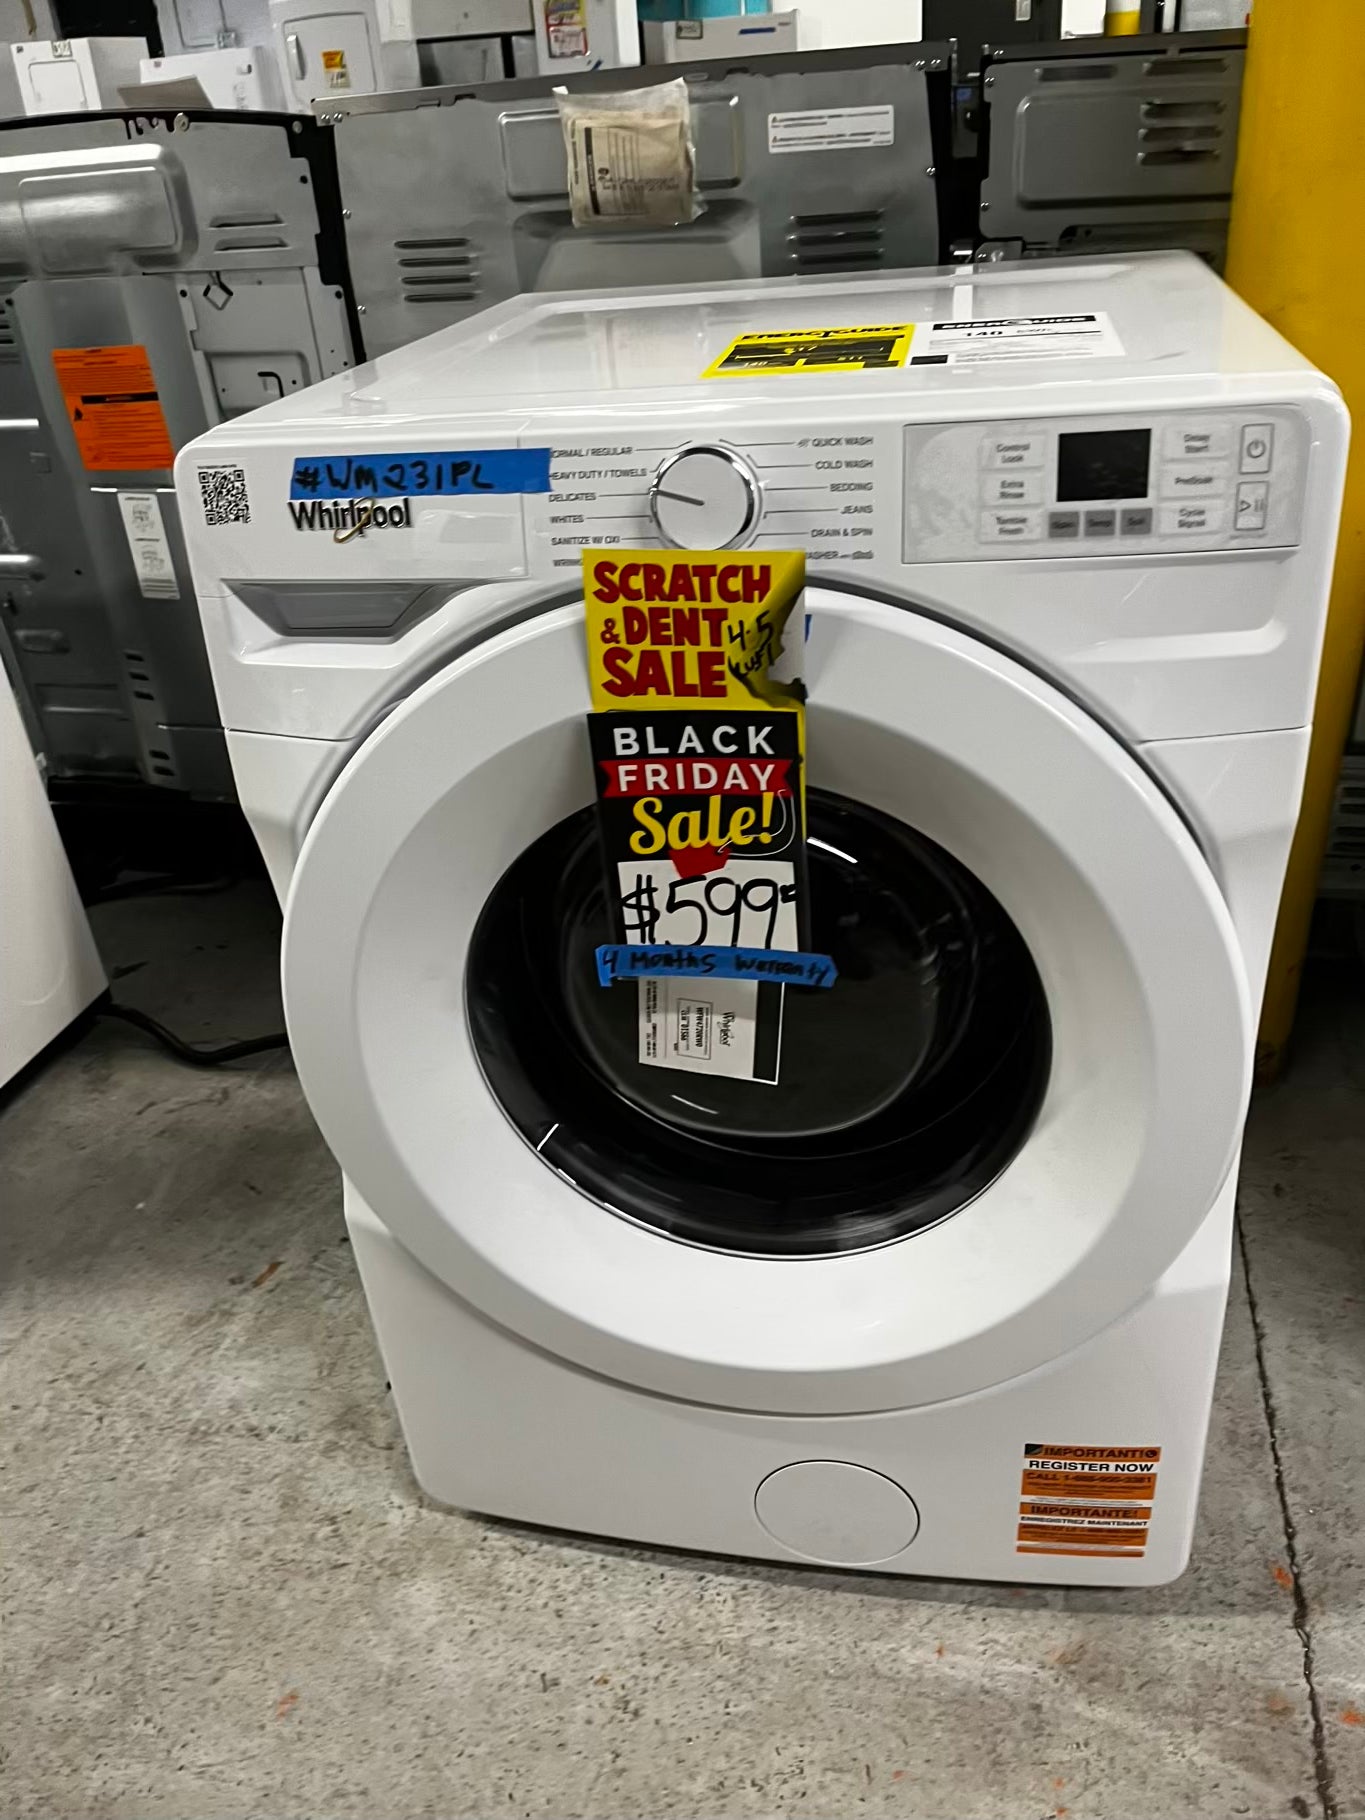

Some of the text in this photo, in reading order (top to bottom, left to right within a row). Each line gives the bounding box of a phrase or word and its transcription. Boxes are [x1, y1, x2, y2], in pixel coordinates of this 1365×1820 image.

[812, 436, 874, 447] QUICK WASH
[591, 447, 633, 457] REGULAR
[815, 459, 874, 470] COLD WASH
[579, 470, 603, 480] DUTY
[611, 468, 647, 478] TOWELS
[830, 481, 873, 492] BEDDING
[548, 492, 596, 503] DELICATES
[840, 504, 874, 515] JEANS
[287, 497, 414, 541] Whirlpool
[550, 514, 584, 524] WHITES
[810, 528, 841, 538] DRAIN
[850, 528, 873, 537] SPIN
[550, 535, 591, 546] SANITIZE
[593, 561, 771, 603] SCRATCH
[600, 606, 729, 647] & DENT
[601, 647, 728, 698] SALE
[613, 725, 775, 756] BLACK
[617, 763, 776, 792] FRIDAY
[629, 792, 775, 855] Sale!
[602, 949, 617, 974] 4
[1044, 1447, 1143, 1459] IMPORTANT!
[1029, 1460, 1154, 1473] REGISTER NOW
[1026, 1472, 1060, 1482] CALL
[1030, 1505, 1139, 1518] IMPORTANTE!
